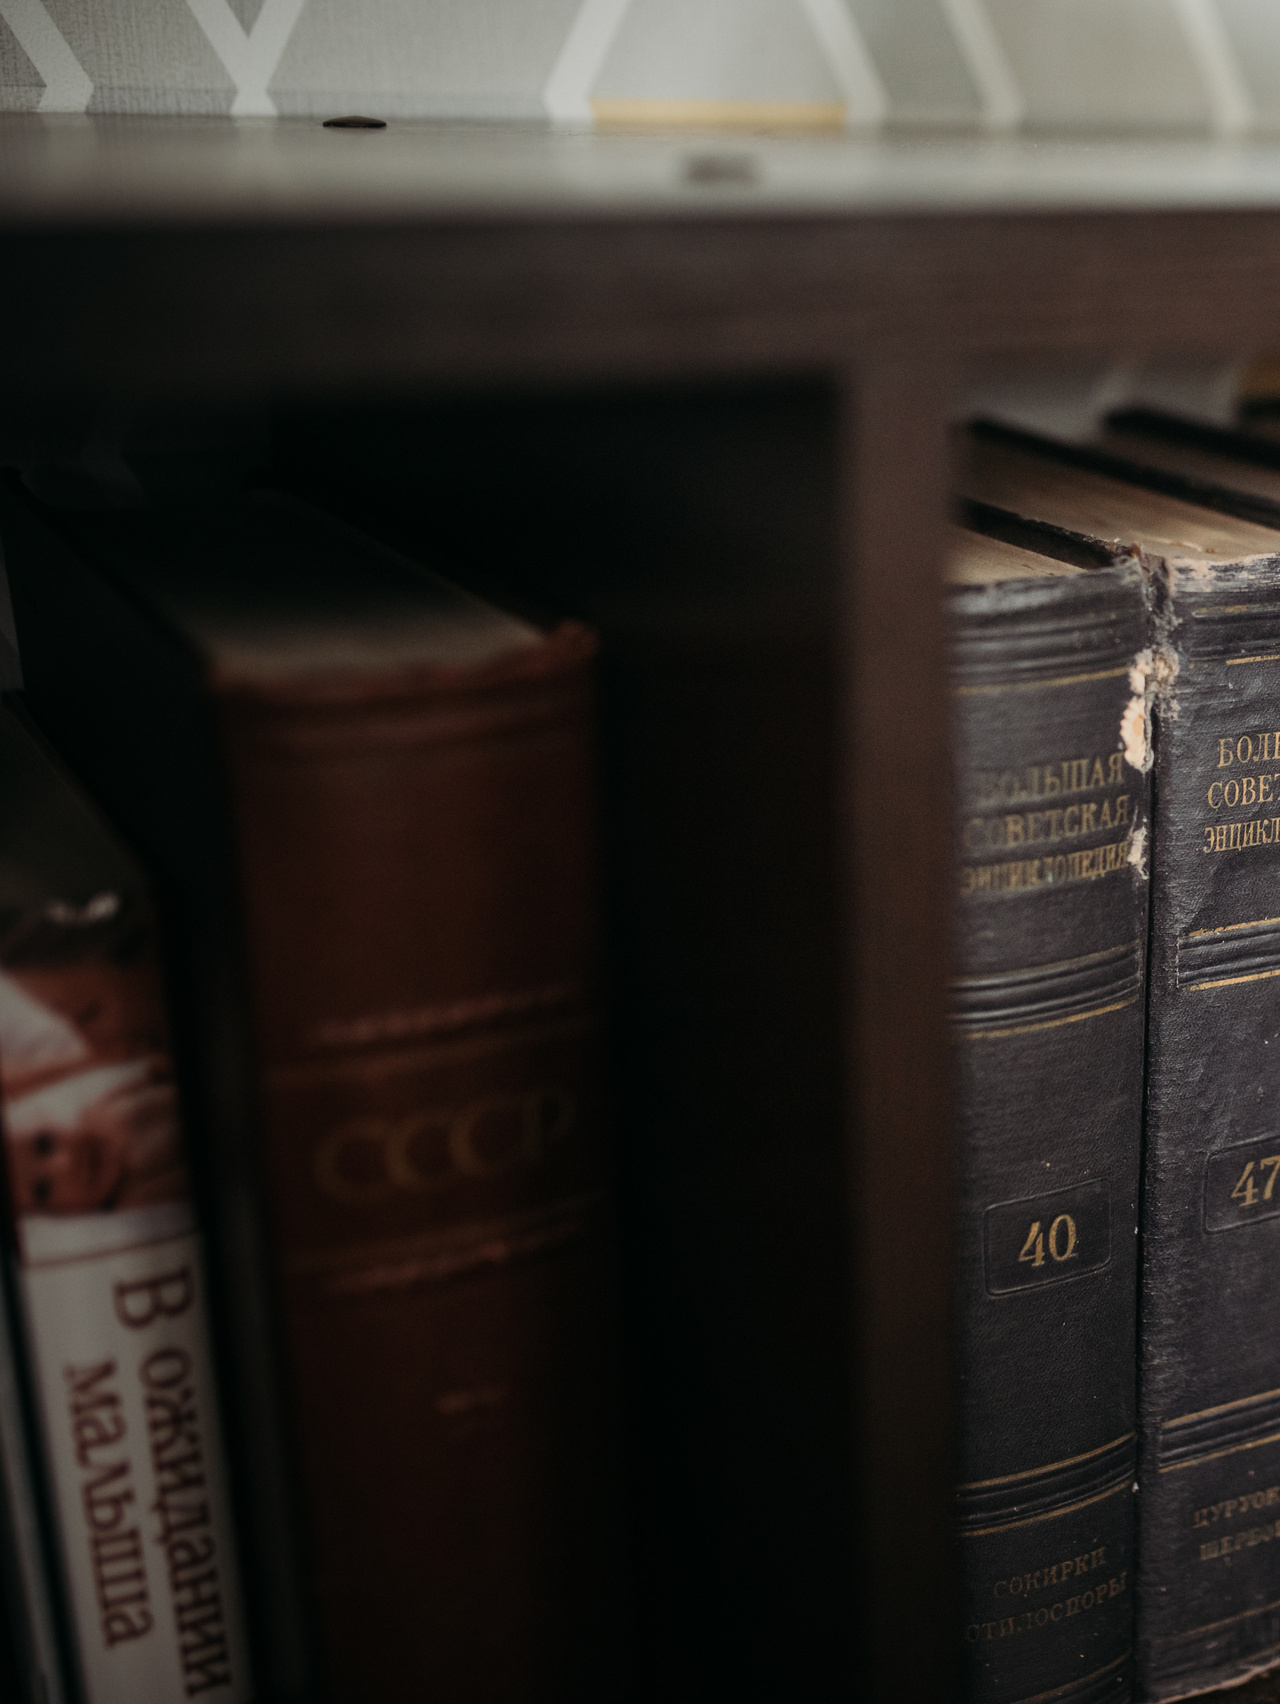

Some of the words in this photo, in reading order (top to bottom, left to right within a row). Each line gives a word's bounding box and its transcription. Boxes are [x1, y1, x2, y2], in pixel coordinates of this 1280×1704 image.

[965, 795, 1130, 848] СОВЕТСКАЯ
[313, 1086, 578, 1198] СССР
[1018, 1214, 1077, 1267] 40
[113, 1268, 194, 1330] В
[63, 1359, 154, 1650] малыша
[140, 1348, 231, 1698] ожидании
